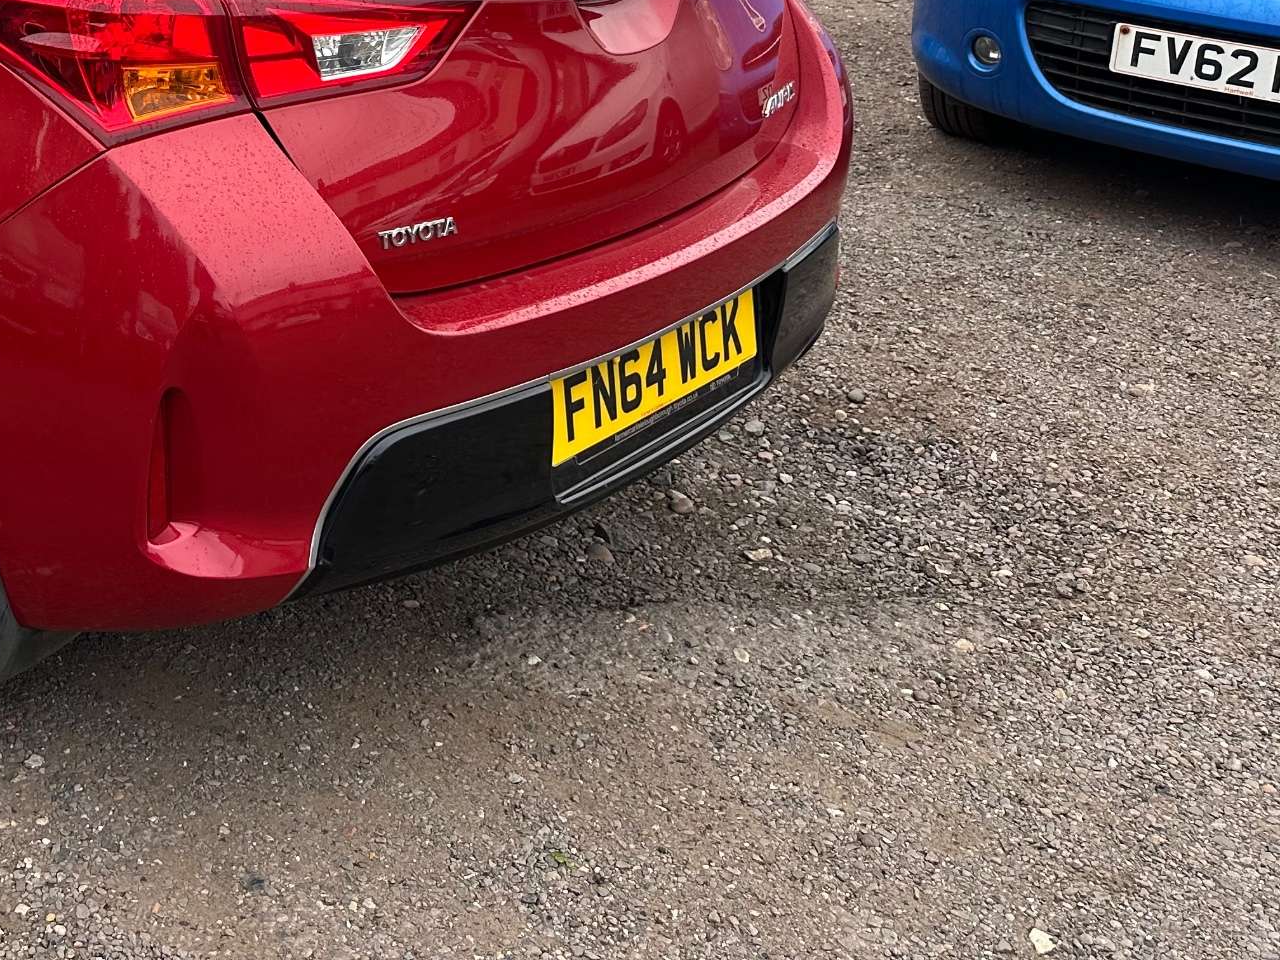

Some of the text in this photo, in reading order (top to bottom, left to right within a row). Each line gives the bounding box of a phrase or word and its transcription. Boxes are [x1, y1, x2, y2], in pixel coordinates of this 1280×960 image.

[1129, 30, 1259, 89] FV62
[377, 216, 458, 250] TOYOTA
[562, 338, 667, 443] FN64
[675, 296, 743, 385] WCK
